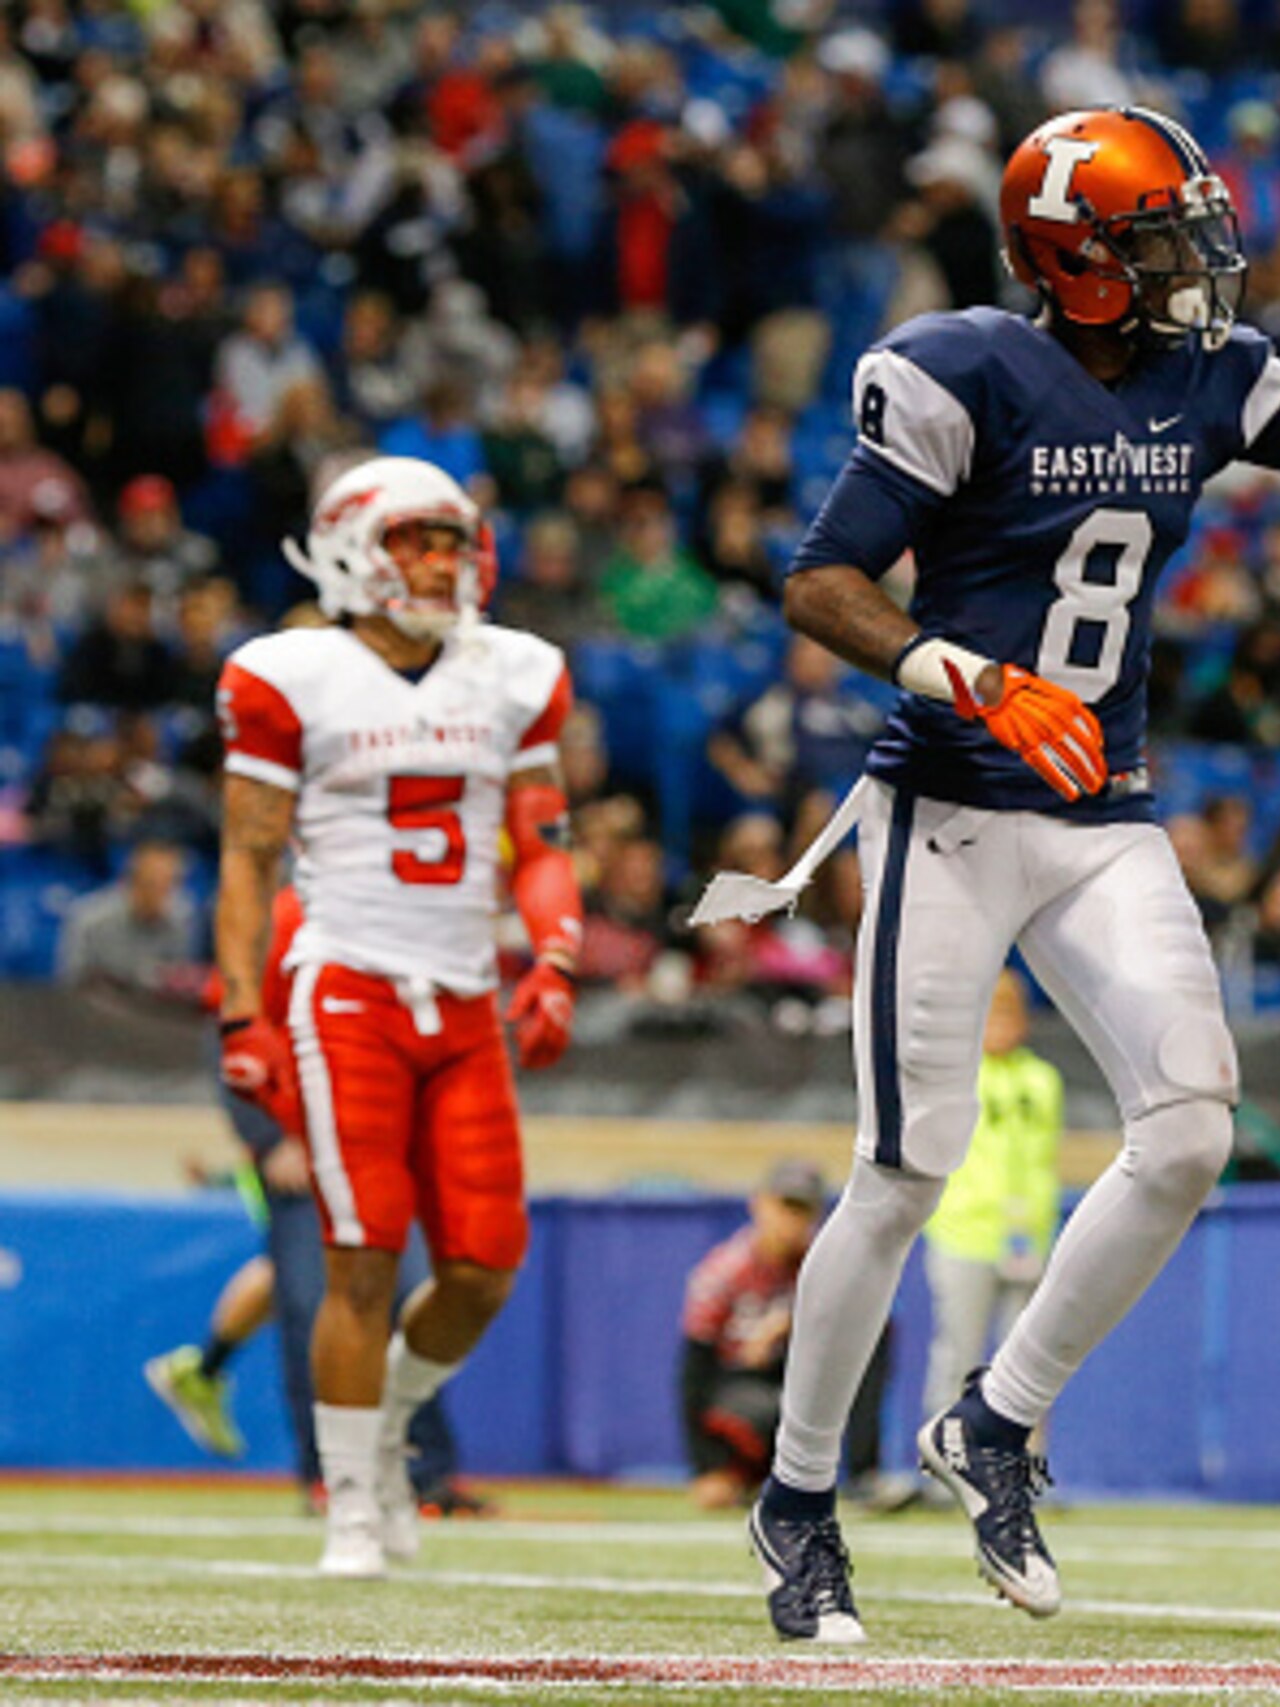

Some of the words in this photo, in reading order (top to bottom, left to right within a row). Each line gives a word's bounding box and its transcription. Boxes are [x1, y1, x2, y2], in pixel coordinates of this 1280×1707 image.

[1028, 137, 1100, 223] I
[862, 382, 888, 446] 8
[1032, 445, 1106, 477] EAST
[1036, 508, 1153, 703] 8
[387, 774, 467, 886] 5
